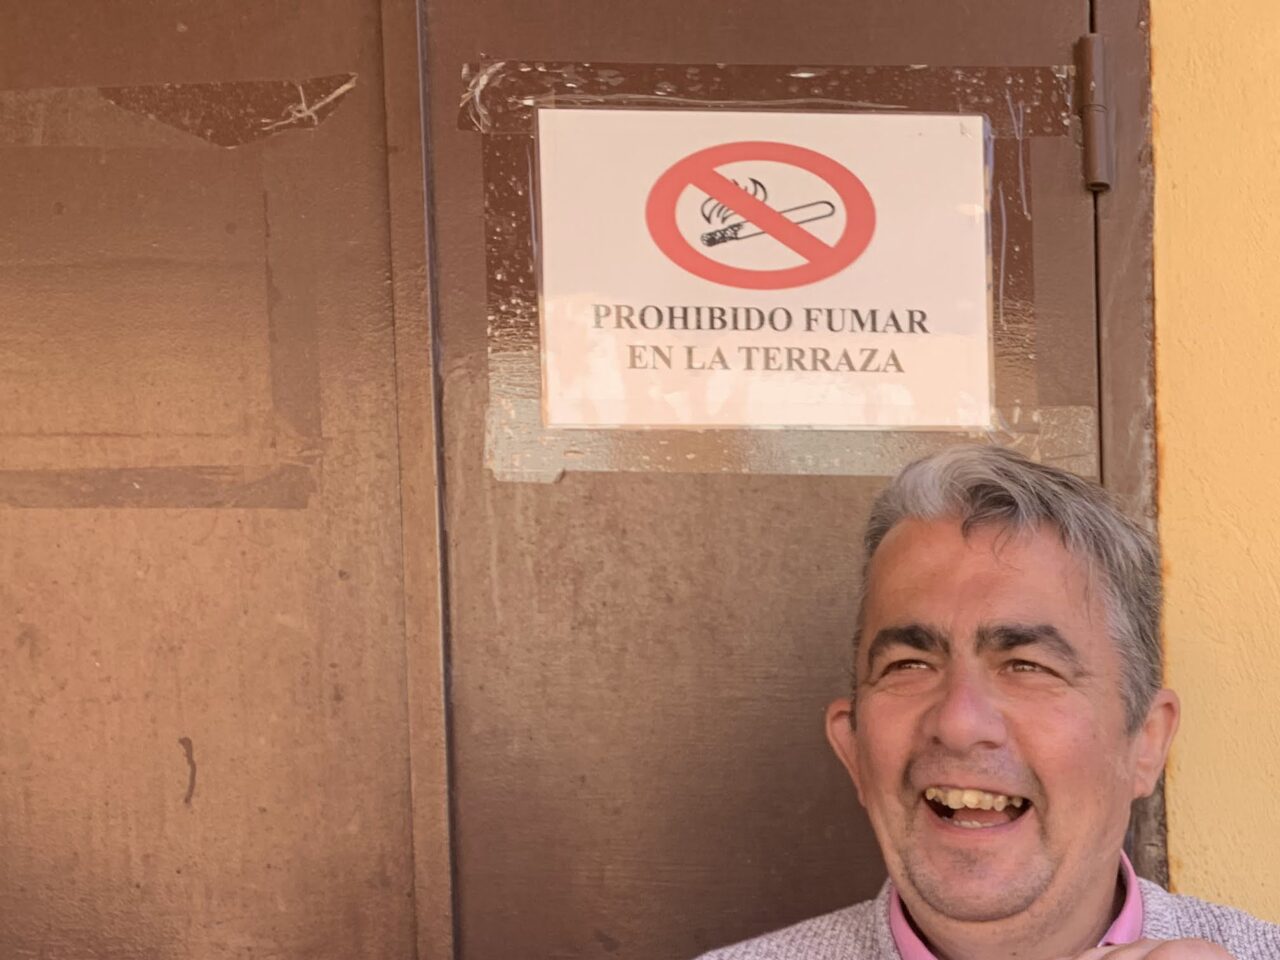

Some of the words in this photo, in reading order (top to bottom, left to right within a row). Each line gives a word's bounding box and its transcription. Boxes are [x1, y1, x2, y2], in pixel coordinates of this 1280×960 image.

[592, 303, 792, 333] PROHIBIDO
[804, 306, 931, 334] FUMAR
[627, 344, 671, 370] EN
[685, 345, 732, 371] LA
[737, 346, 906, 373] TERRAZA
